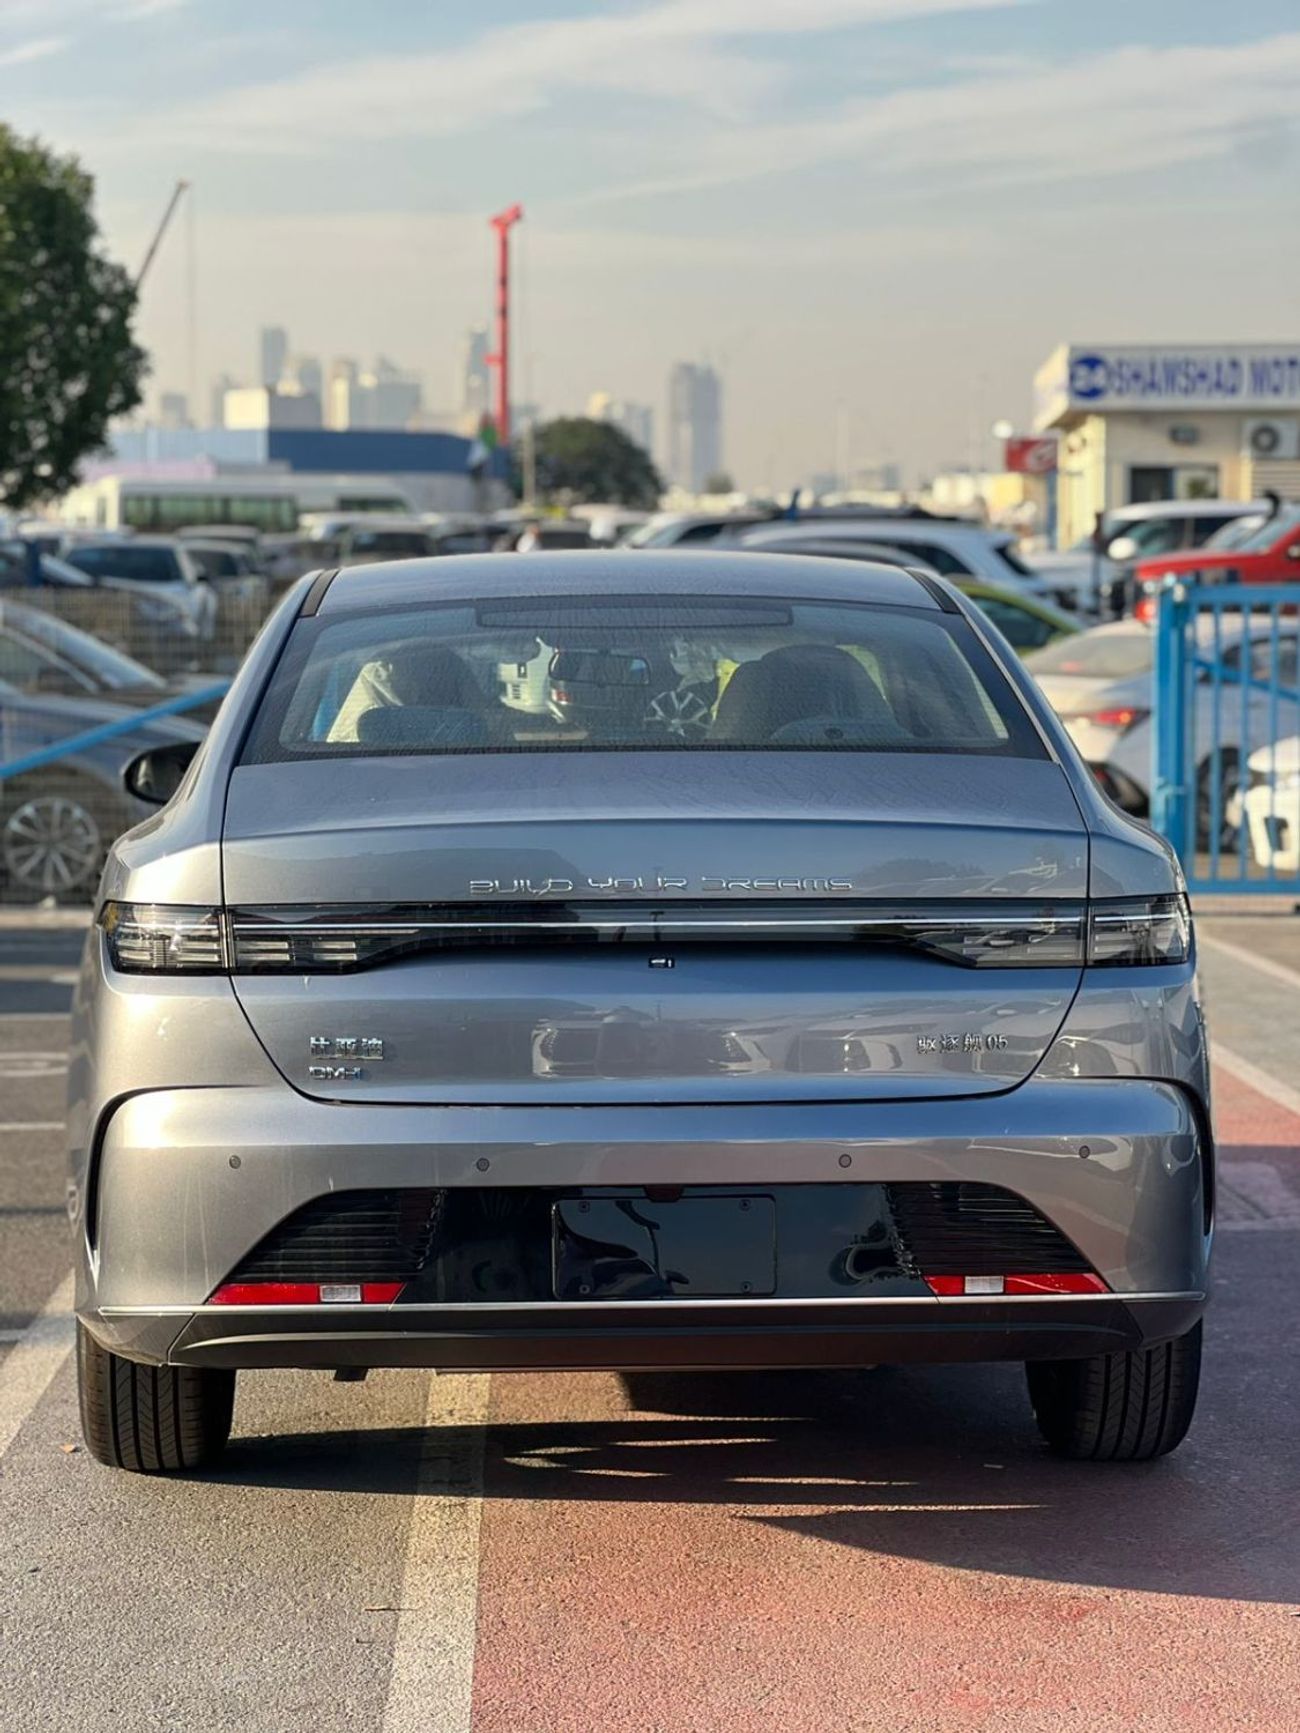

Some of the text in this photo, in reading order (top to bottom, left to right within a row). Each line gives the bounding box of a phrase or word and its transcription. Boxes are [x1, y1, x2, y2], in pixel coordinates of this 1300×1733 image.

[469, 876, 853, 896] BUILD YOUR DREAMS
